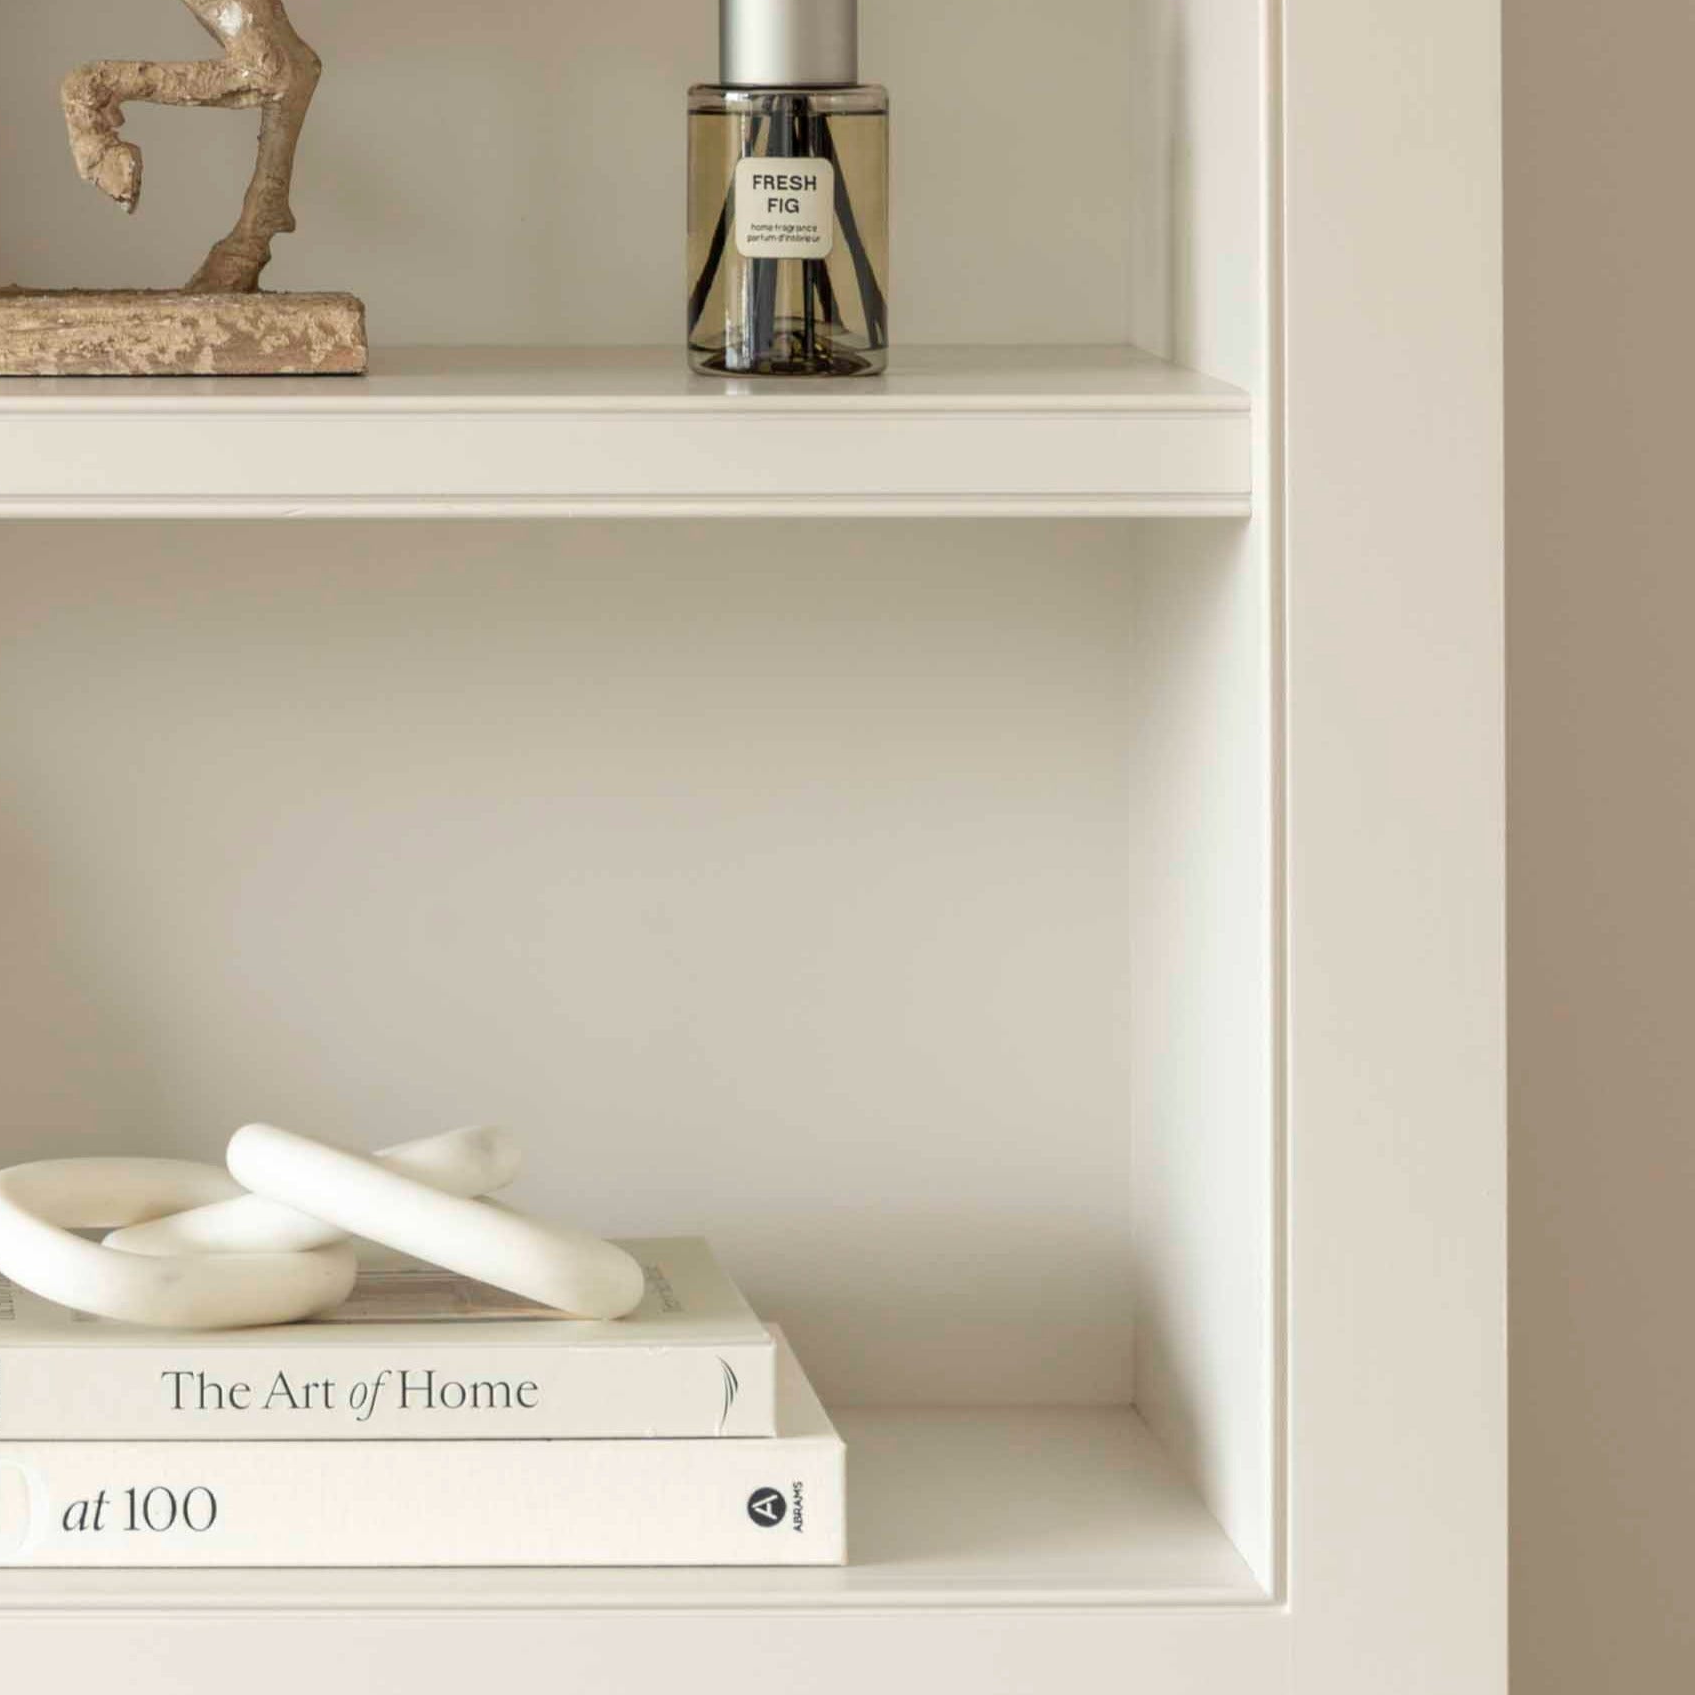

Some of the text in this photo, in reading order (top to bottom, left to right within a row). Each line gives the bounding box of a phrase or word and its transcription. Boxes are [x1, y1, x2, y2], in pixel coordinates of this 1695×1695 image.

[753, 174, 817, 191] FRESH
[768, 197, 800, 214] FIG
[751, 223, 818, 234] home fragrance
[747, 233, 776, 243] parfum
[161, 1369, 540, 1422] The Art of Home
[62, 1488, 111, 1532] at
[123, 1486, 217, 1532] 100
[792, 1481, 804, 1534] ABRAMS
